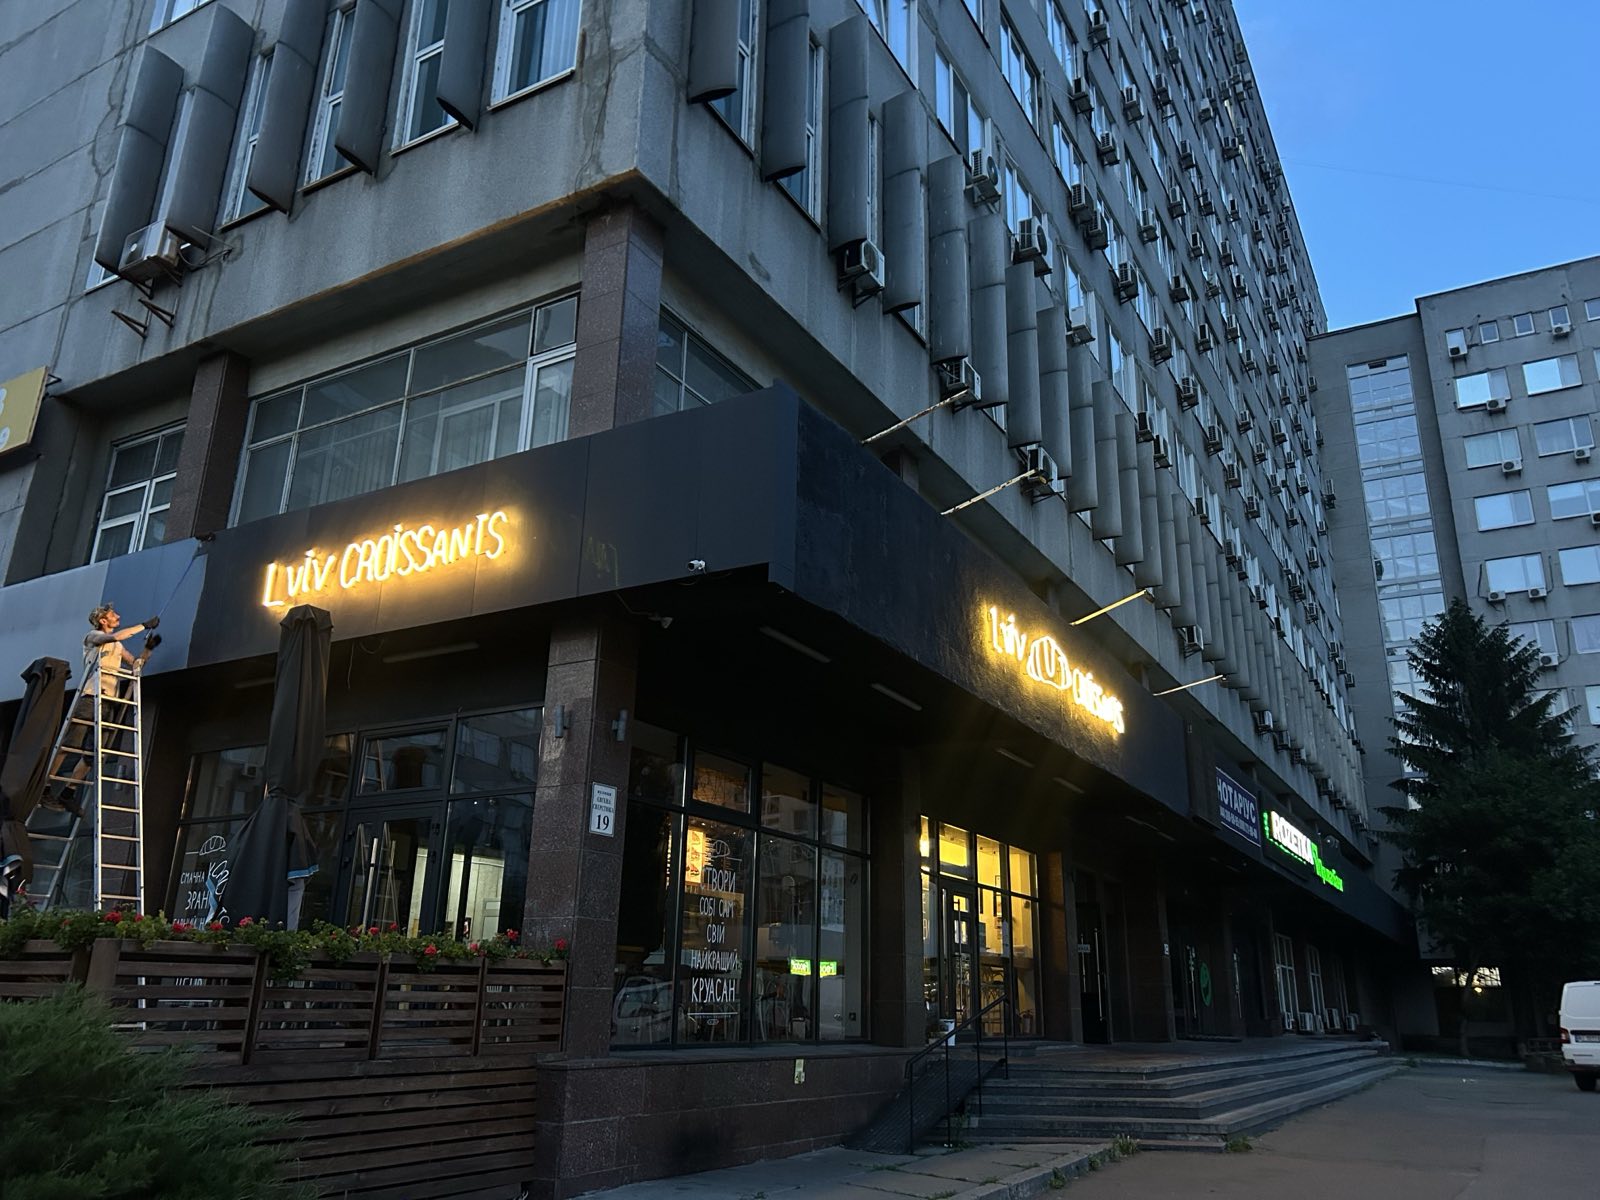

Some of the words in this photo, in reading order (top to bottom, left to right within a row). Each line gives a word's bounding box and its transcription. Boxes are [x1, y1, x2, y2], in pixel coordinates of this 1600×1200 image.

[1216, 777, 1256, 824] НОТАРІУС
[596, 813, 610, 831] 19
[699, 896, 716, 918] СОБІ
[718, 899, 735, 918] САМ
[706, 921, 726, 944] СВІЙ
[690, 947, 739, 972] НАЙКРАЩИЙ
[691, 976, 736, 1004] КРУАСАН
